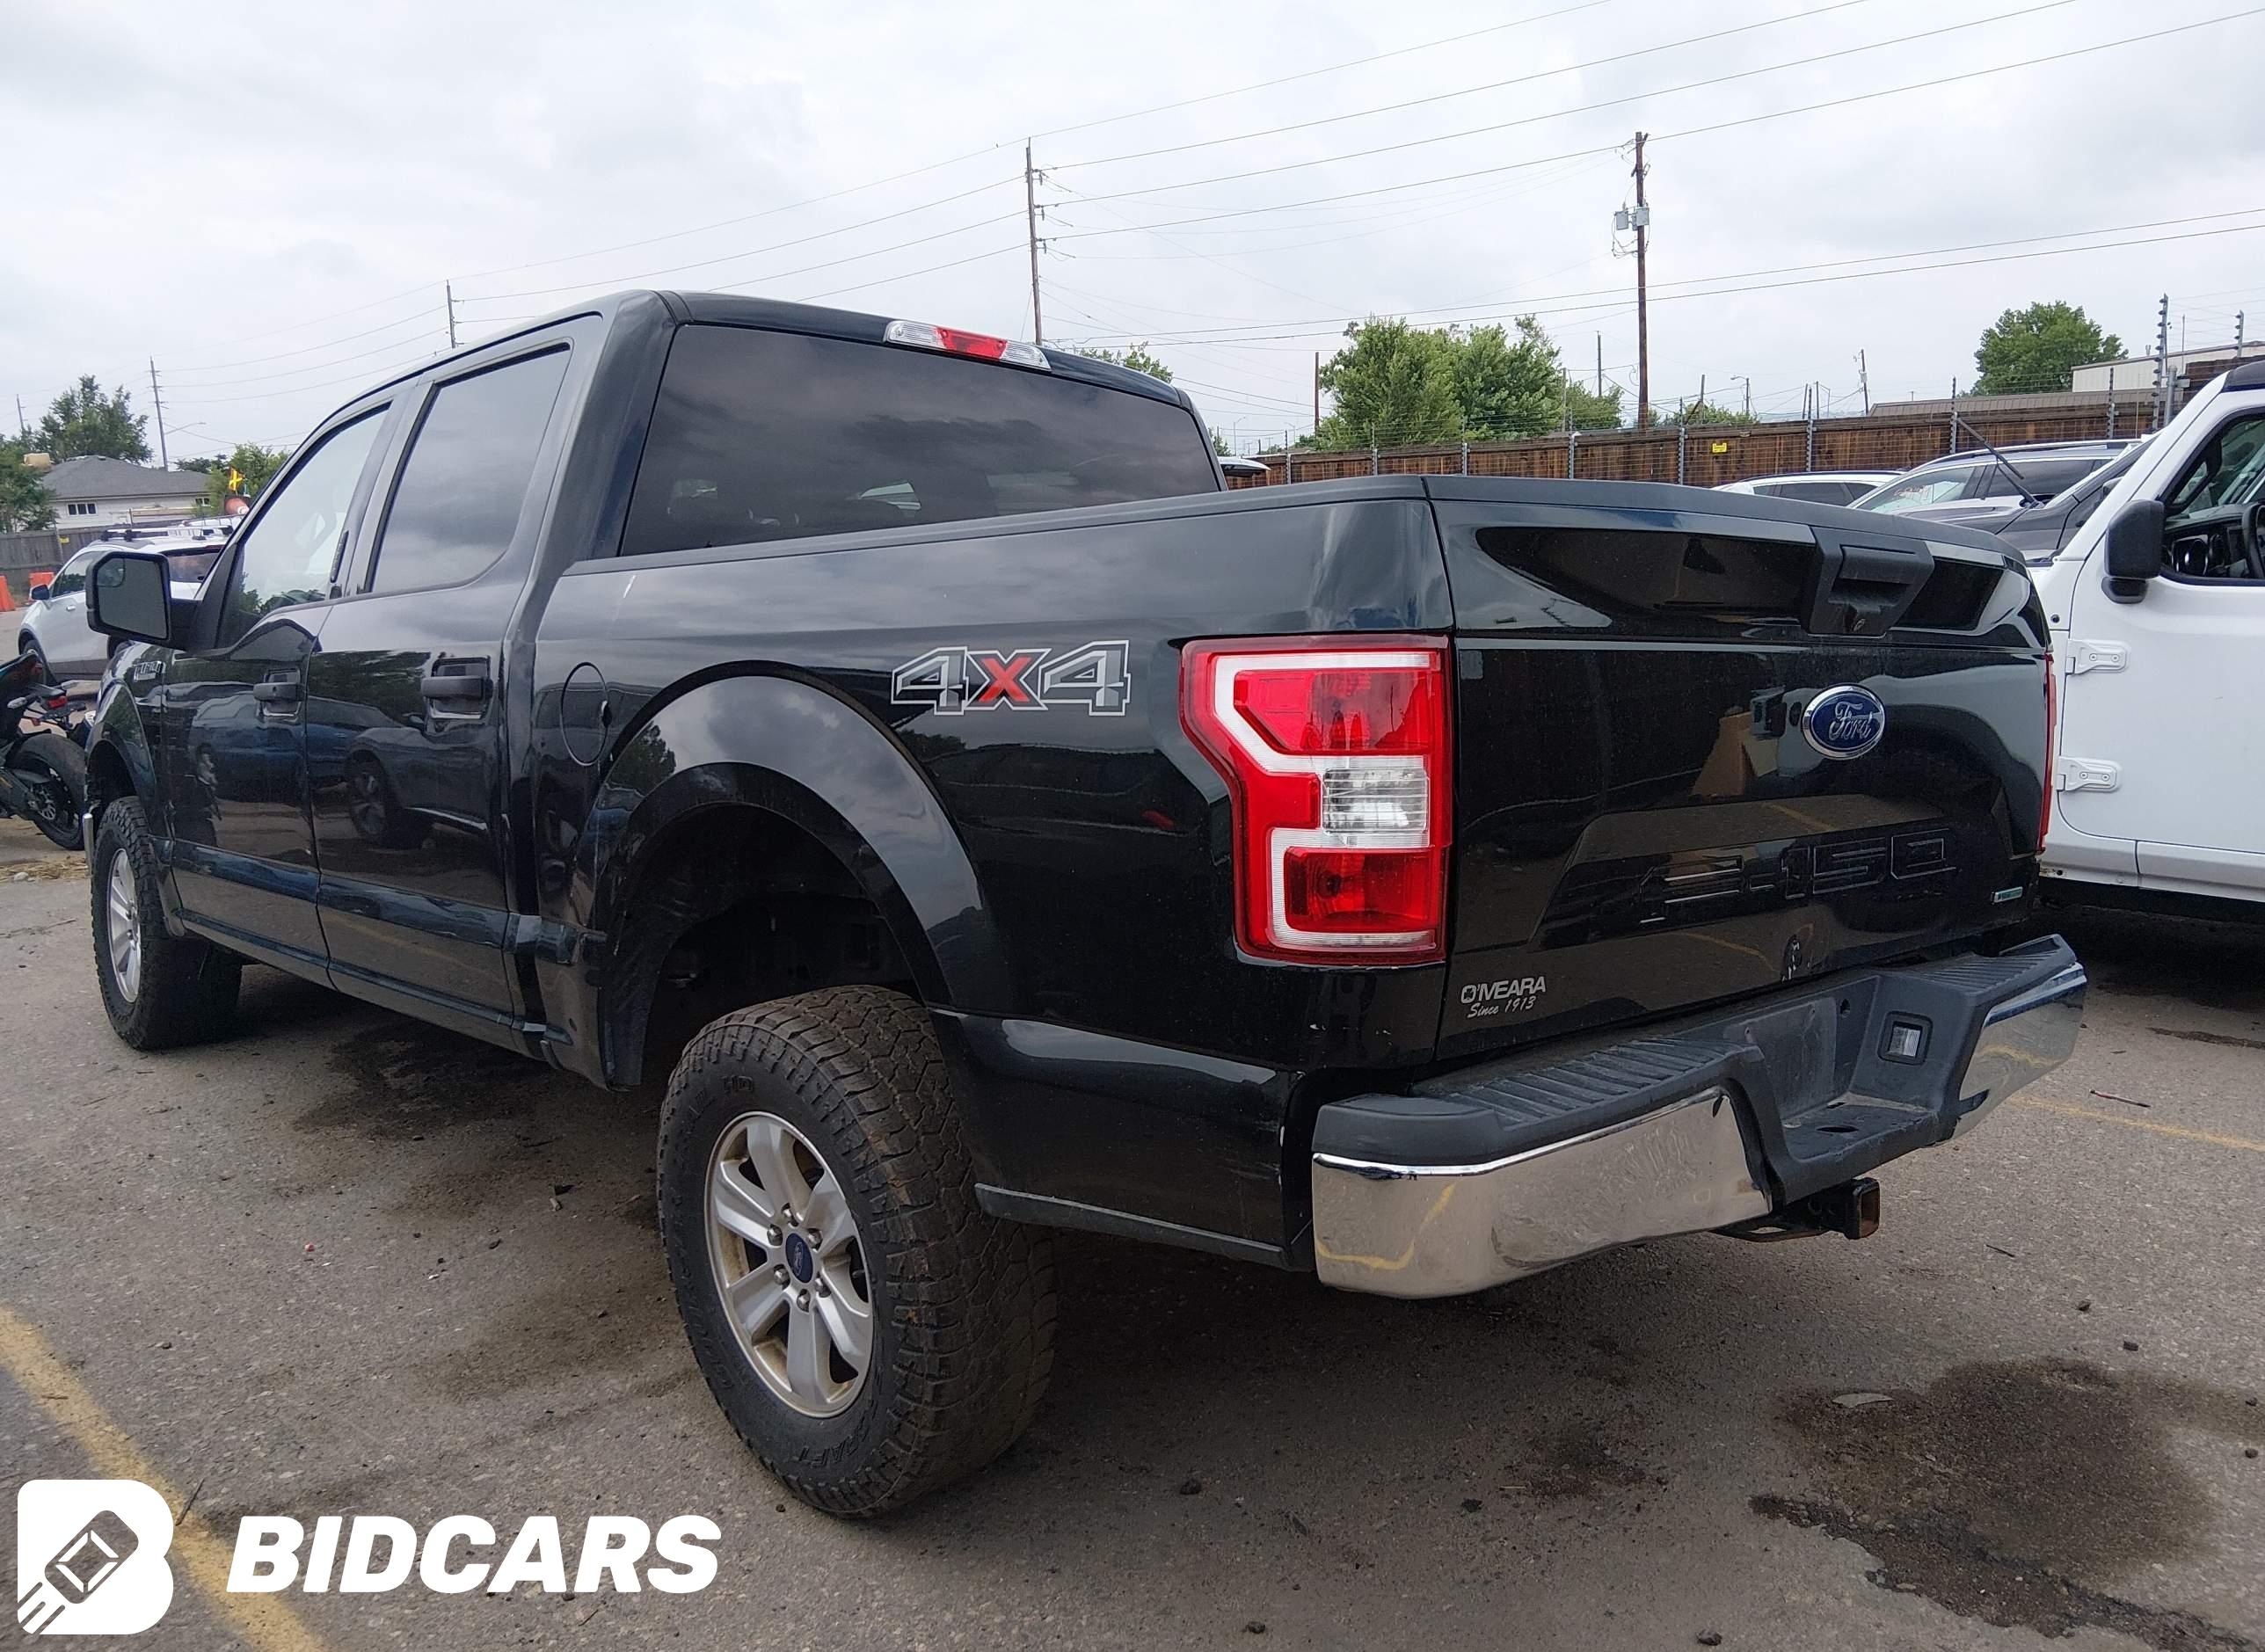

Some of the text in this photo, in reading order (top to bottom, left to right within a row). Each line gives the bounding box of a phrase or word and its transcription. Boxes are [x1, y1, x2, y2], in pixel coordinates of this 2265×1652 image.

[1829, 701, 1872, 740] Ford
[1467, 995, 1537, 1018] Since 1913
